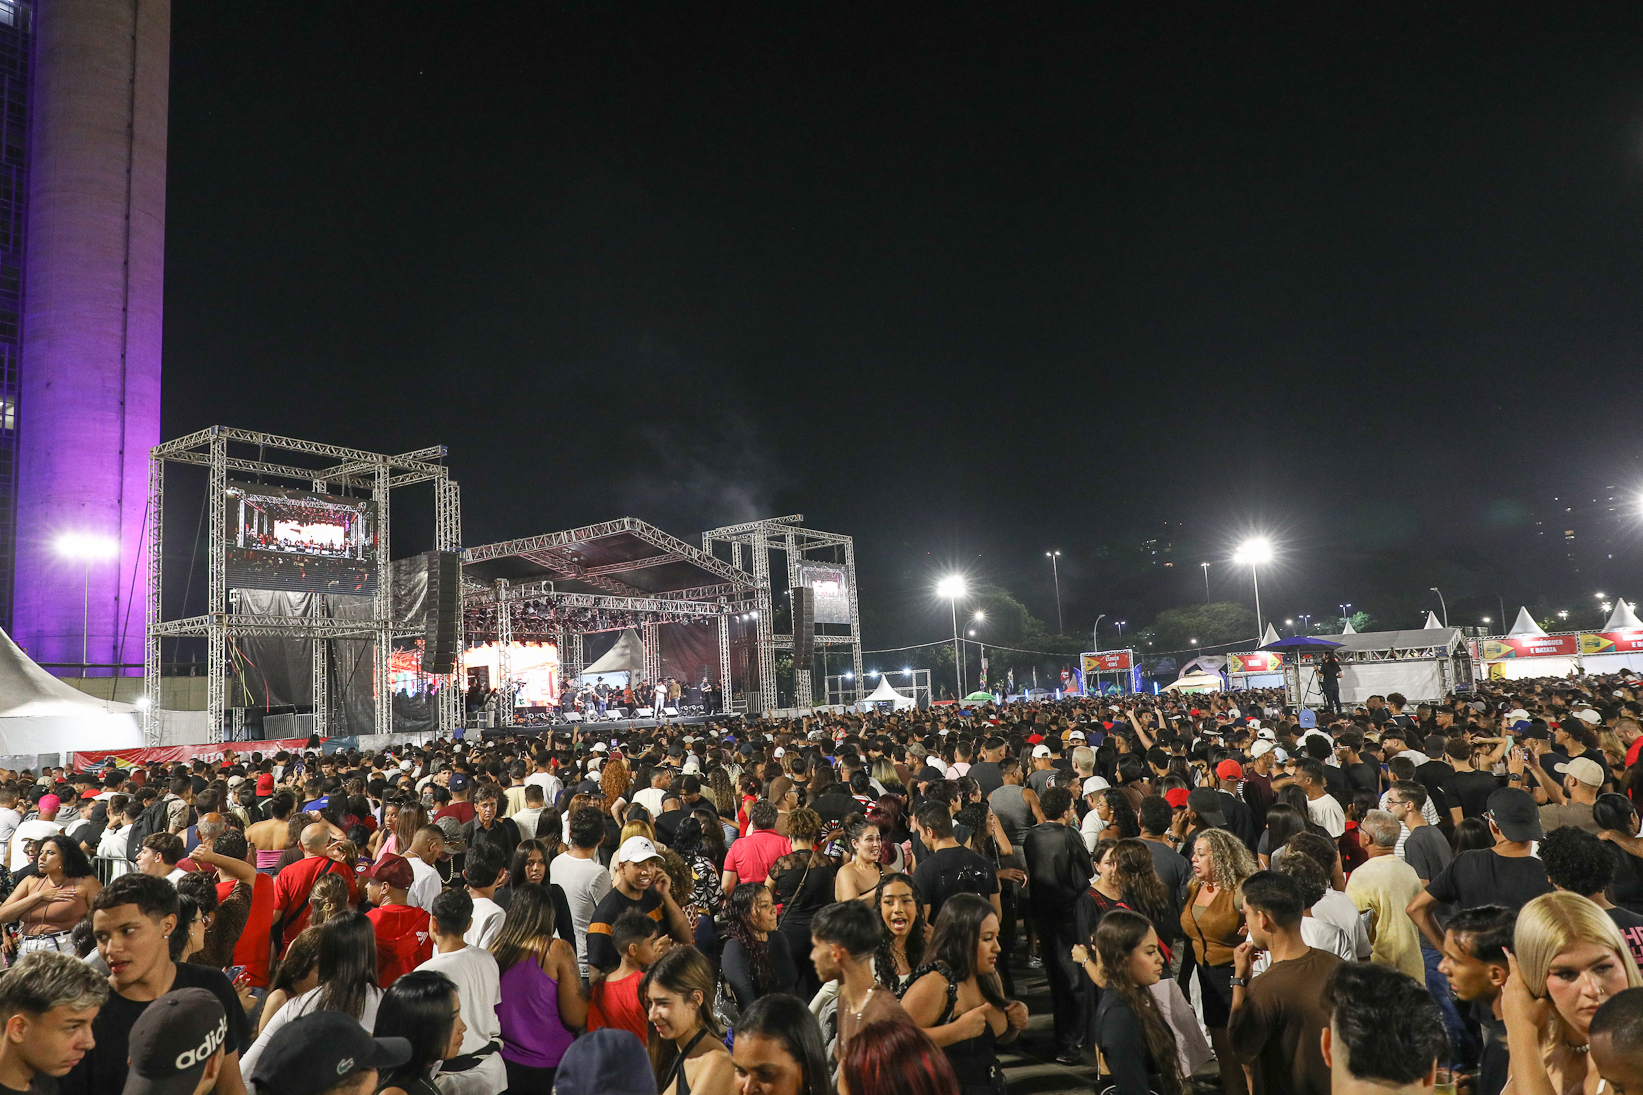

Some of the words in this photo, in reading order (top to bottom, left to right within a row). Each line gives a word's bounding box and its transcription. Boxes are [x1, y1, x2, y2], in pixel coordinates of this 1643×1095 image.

[1521, 638, 1563, 648] ÚRGUER
[1535, 646, 1557, 654] BATATA
[175, 1014, 228, 1069] adid
